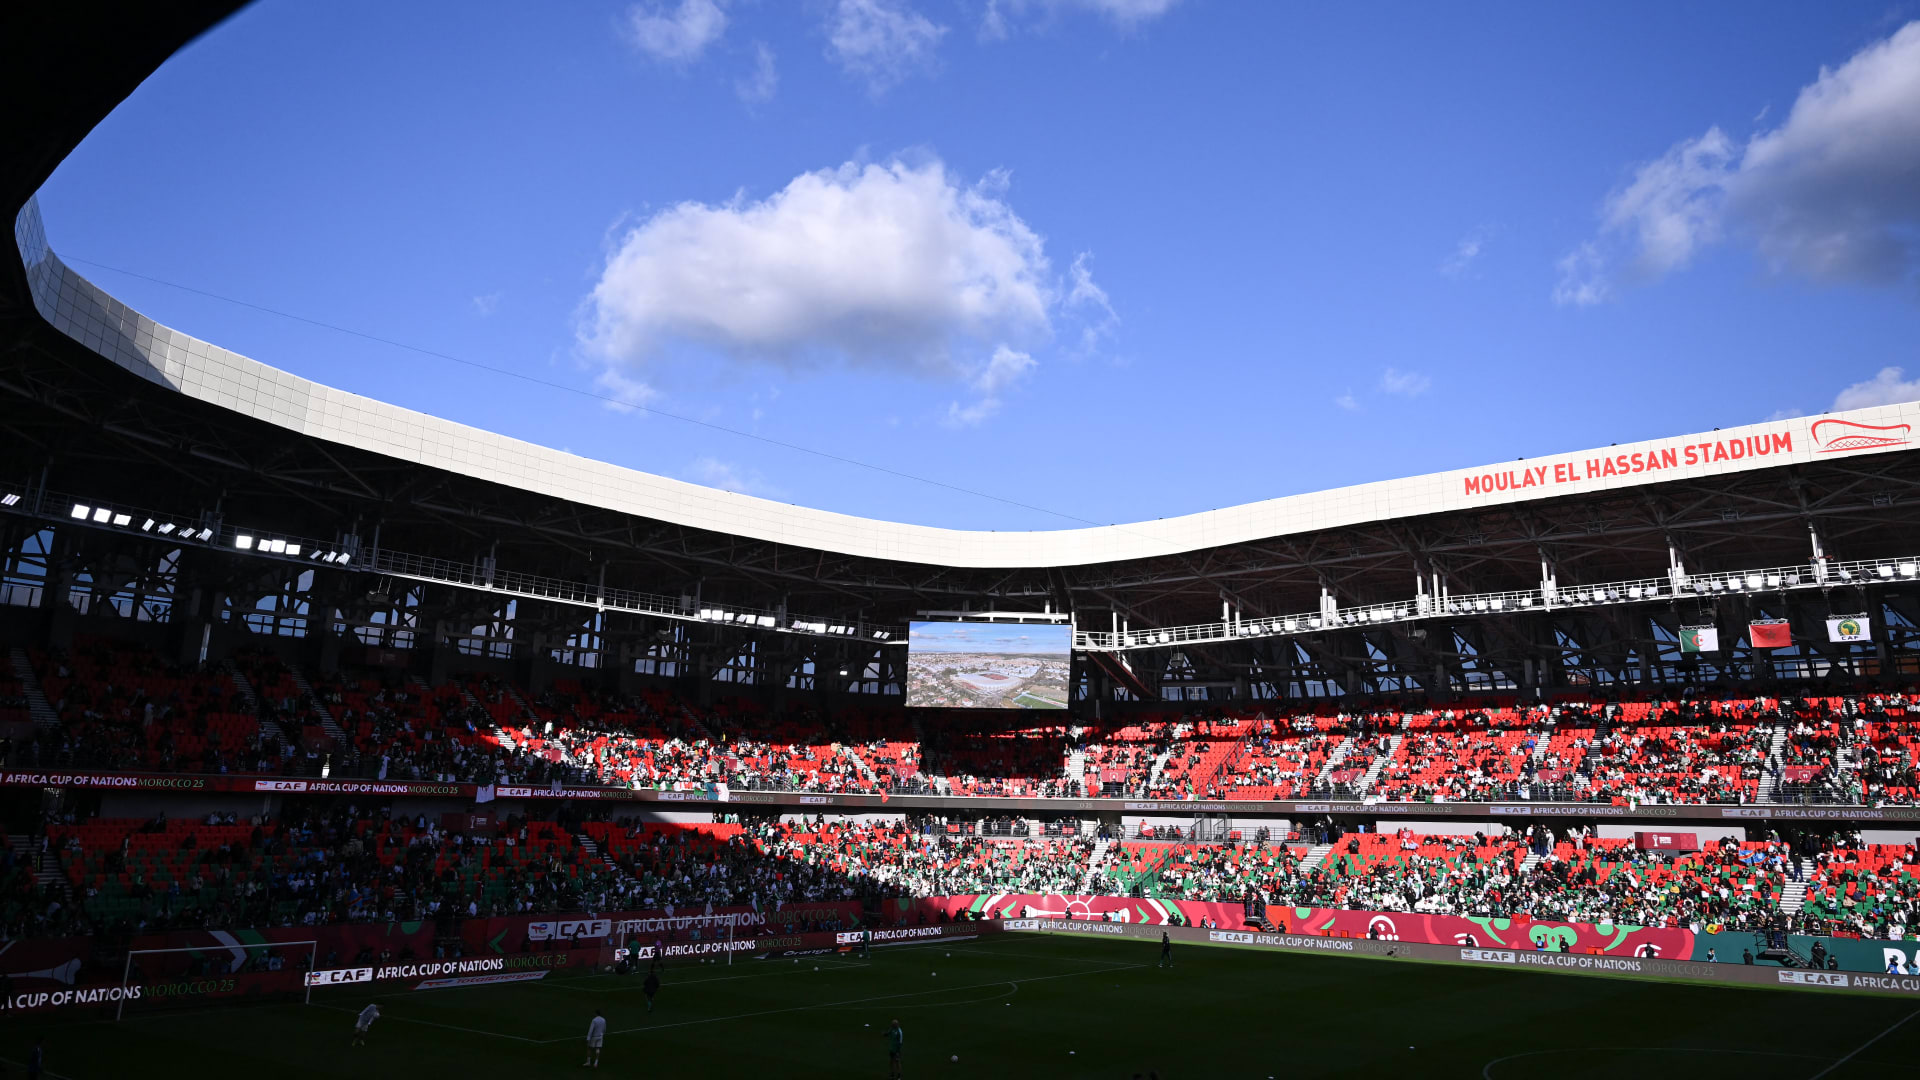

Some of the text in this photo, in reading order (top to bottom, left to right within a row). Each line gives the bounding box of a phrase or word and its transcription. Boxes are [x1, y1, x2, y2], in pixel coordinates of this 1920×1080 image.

[1465, 432, 1792, 495] MOULAY EL HASSAN STADIUM
[6, 774, 205, 788] AFRICA CUP OF NATIONS MOROCCO 25
[309, 783, 459, 794] AFRICA CUP OF NATIONS MOROCCO 25
[568, 790, 576, 798] OF
[576, 790, 600, 798] NATIONS
[1842, 810, 1883, 818] NATIONS
[561, 922, 602, 936] CAF
[616, 917, 664, 934] AFRICA
[713, 912, 766, 928] NATIONS
[1014, 920, 1034, 928] CAF
[1041, 921, 1067, 930] AFRICA
[1068, 922, 1084, 931] CUP
[1084, 923, 1092, 931] OF
[1093, 924, 1123, 933] NATIONS
[1123, 925, 1161, 935] MOROCCO
[874, 928, 896, 940] AFRICA
[896, 928, 909, 939] CUP
[909, 928, 917, 937] OF
[917, 926, 942, 937] NATIONS
[1226, 933, 1249, 941] CAF
[665, 937, 801, 956] AFRICA CUP OF NATIONS MOROCCO 25
[1256, 935, 1286, 945] AFRICA
[1286, 937, 1303, 946] CUP
[1304, 938, 1315, 947] OF
[1316, 939, 1353, 950] NATIONS
[1401, 944, 1411, 954] 25
[784, 948, 832, 956] Orange
[1481, 951, 1510, 960] CAF
[376, 964, 418, 979] AFRICA
[419, 963, 442, 976] CUP
[442, 961, 457, 973] OF
[458, 958, 503, 973] NATIONS
[557, 954, 567, 965] 25
[1519, 953, 1556, 965] AFRICA
[1557, 955, 1576, 966] CUP
[1578, 957, 1592, 968] OF
[1595, 958, 1641, 971] NATIONS
[1703, 966, 1714, 976] 25
[1883, 948, 1920, 975] R
[331, 970, 366, 982] CAF
[1805, 974, 1840, 984] CAF
[1853, 977, 1919, 990] AFRICA CU
[16, 993, 48, 1008] CUP
[51, 990, 73, 1006] OF
[75, 985, 141, 1003] NATIONS
[143, 981, 217, 997] MOROCCO
[220, 979, 235, 992] 25
